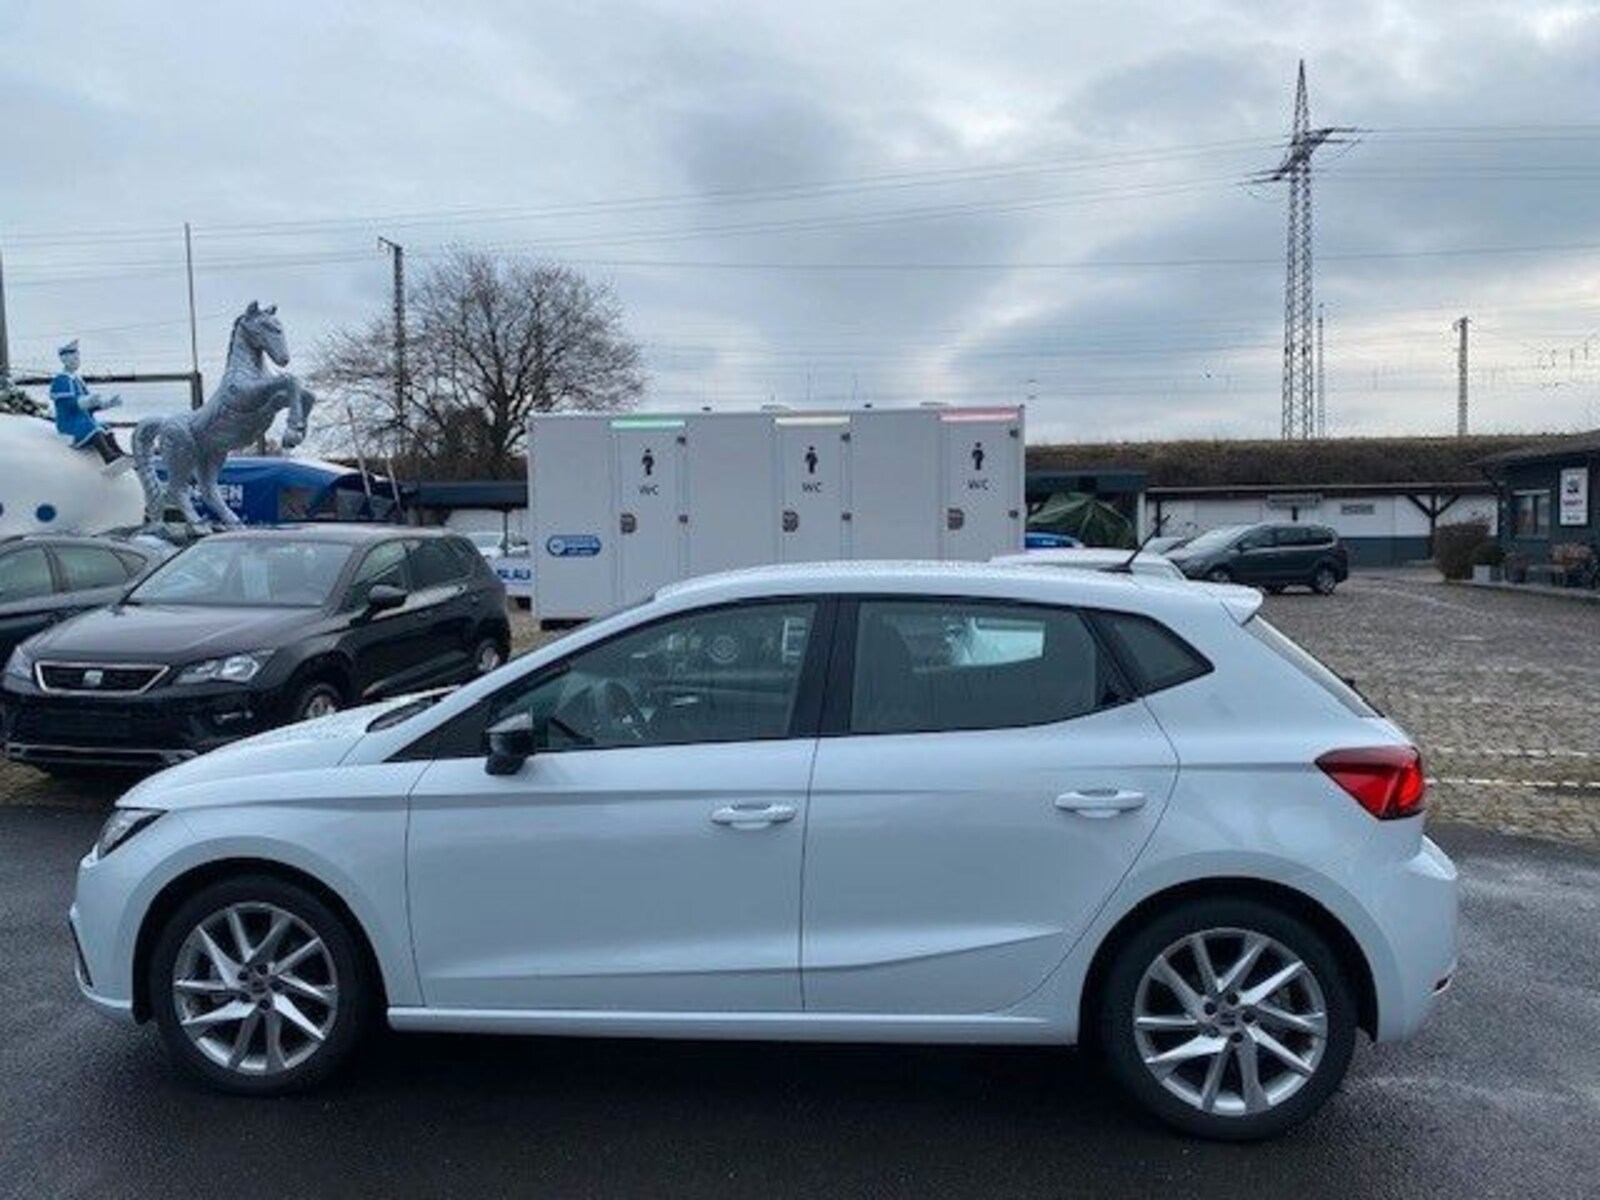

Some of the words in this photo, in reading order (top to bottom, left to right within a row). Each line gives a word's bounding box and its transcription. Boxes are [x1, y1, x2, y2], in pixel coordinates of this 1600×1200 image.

[639, 484, 659, 496] WC
[802, 481, 821, 493] WC
[967, 478, 989, 490] WC
